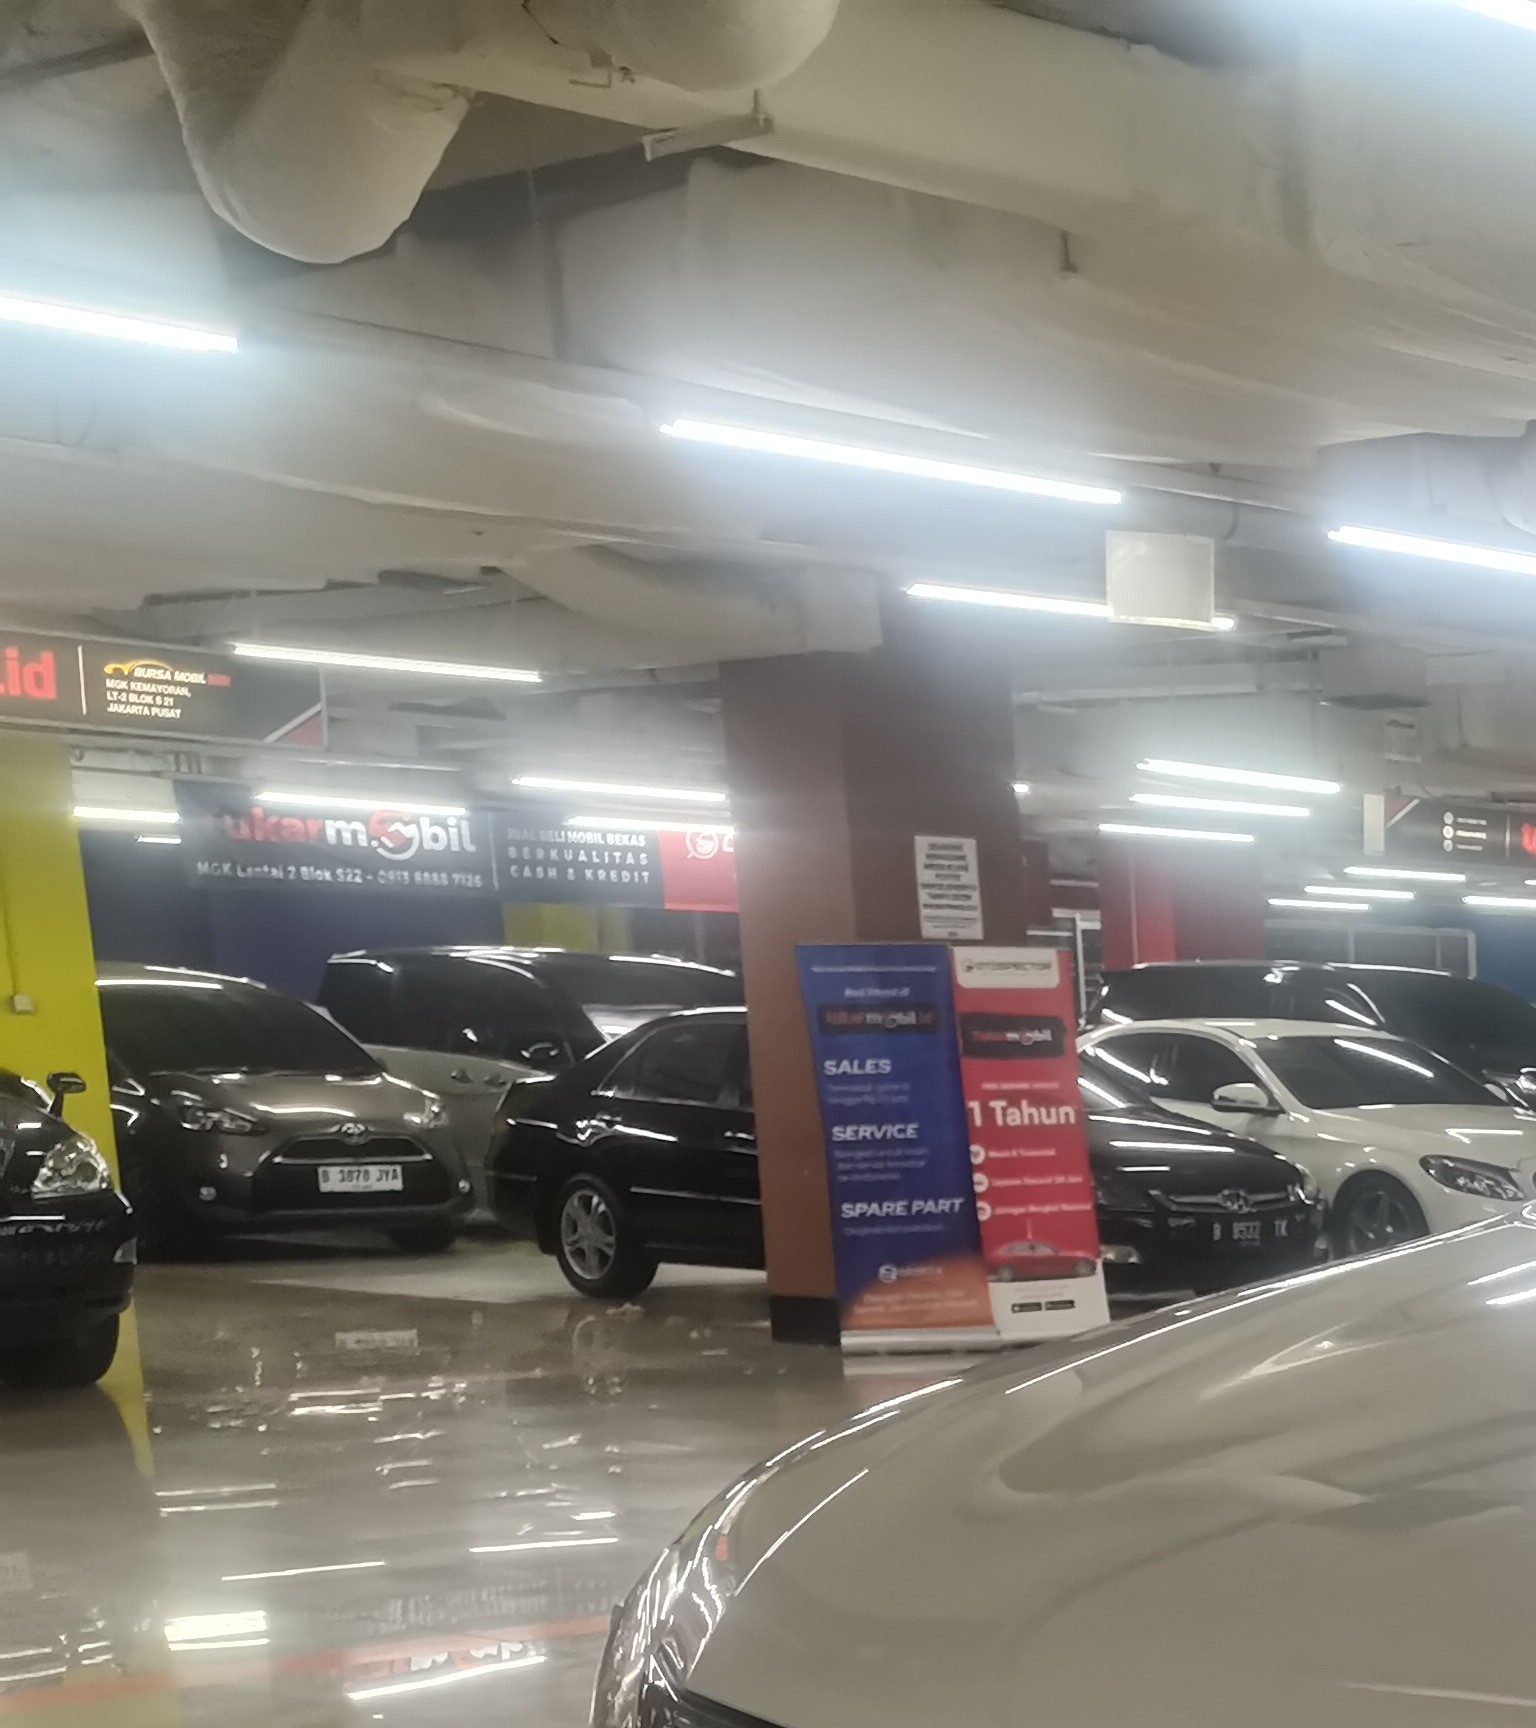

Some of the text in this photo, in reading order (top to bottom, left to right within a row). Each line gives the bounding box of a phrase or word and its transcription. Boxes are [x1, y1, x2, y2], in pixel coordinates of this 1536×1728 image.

[105, 678, 129, 690] MGK
[133, 667, 172, 681] BURSA
[174, 670, 207, 685] MOBIL
[128, 693, 154, 707] BLOK
[106, 702, 182, 719] JAKARTA PUSAT
[567, 830, 605, 846] MOBIL
[606, 832, 647, 848] BEKAS
[584, 868, 651, 885] KREDIT
[823, 1058, 893, 1076] SALES
[968, 1099, 1076, 1128] 1 Tahun
[831, 1123, 919, 1142] SERVICE
[841, 1197, 965, 1219] SPARE PART
